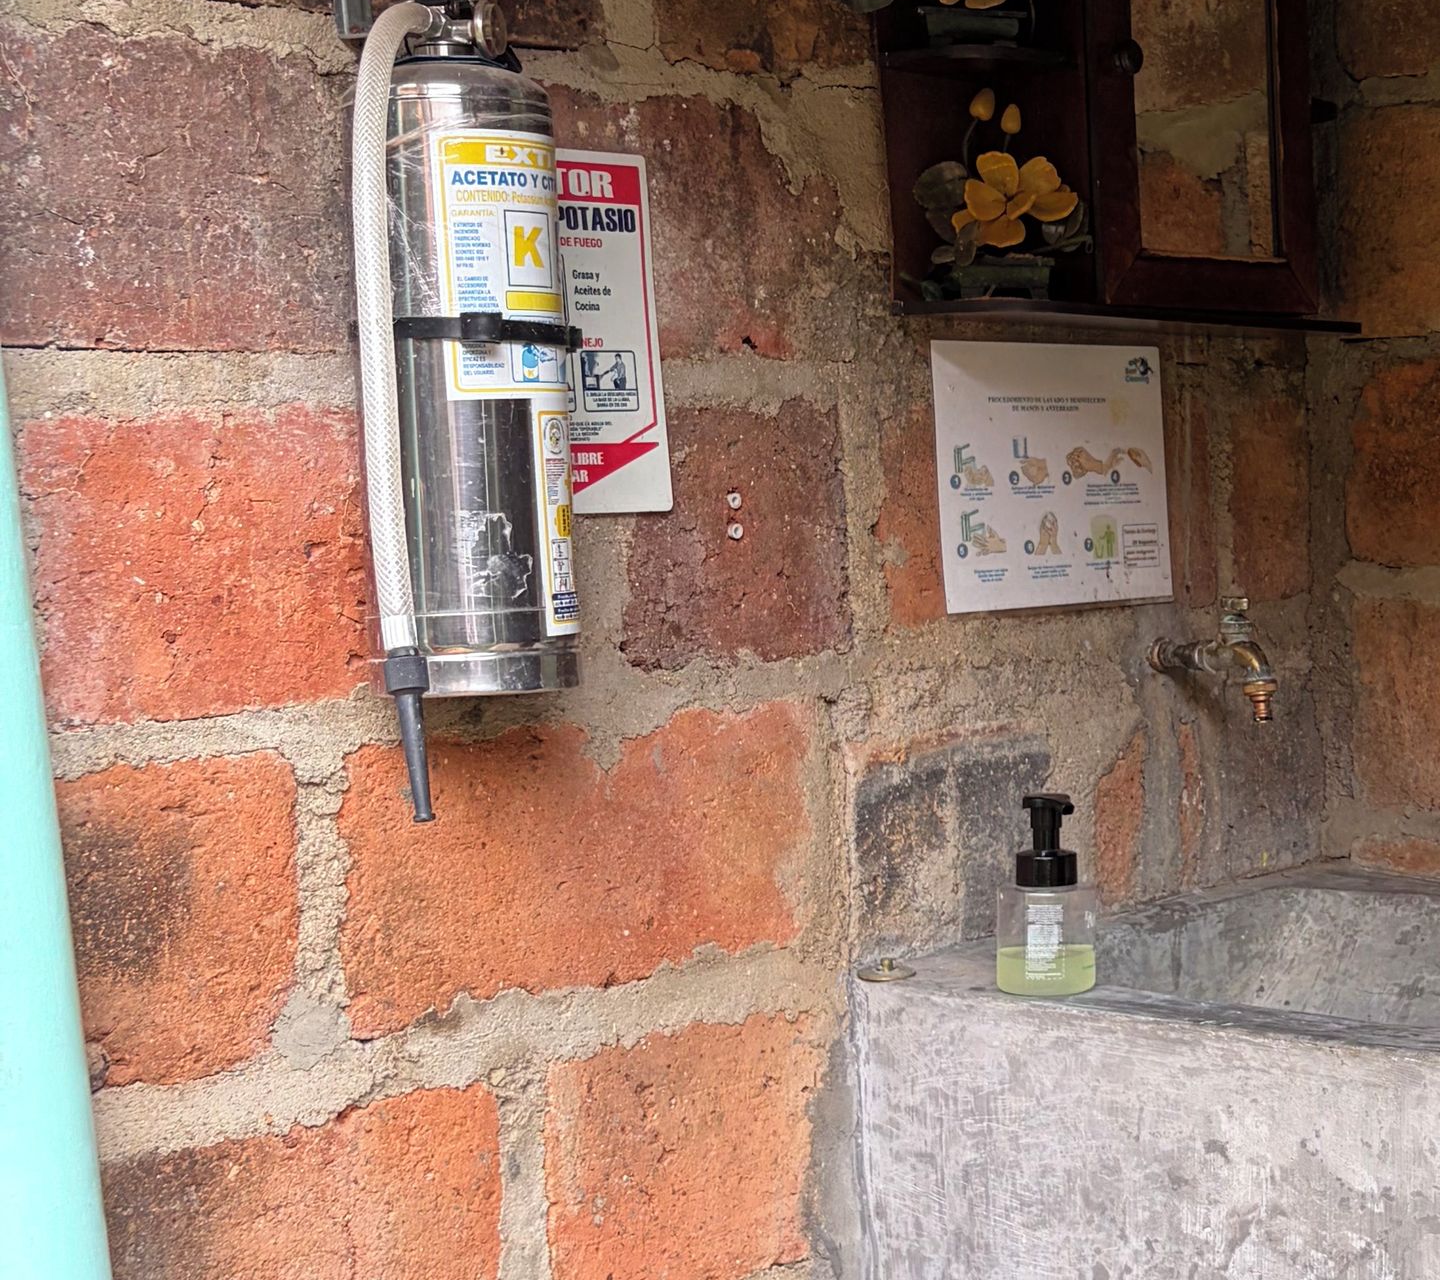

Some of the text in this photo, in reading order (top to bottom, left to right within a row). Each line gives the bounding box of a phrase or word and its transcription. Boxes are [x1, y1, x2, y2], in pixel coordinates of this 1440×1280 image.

[452, 170, 527, 188] ACETATO
[531, 174, 539, 189] Y
[456, 189, 510, 203] CONTENIDO:
[513, 225, 544, 269] K
[560, 236, 603, 248] DE FUEGO
[572, 269, 600, 282] Grasa y
[574, 285, 612, 296] Aceites de
[575, 301, 600, 311] Cocina
[571, 451, 604, 465] LIBRE
